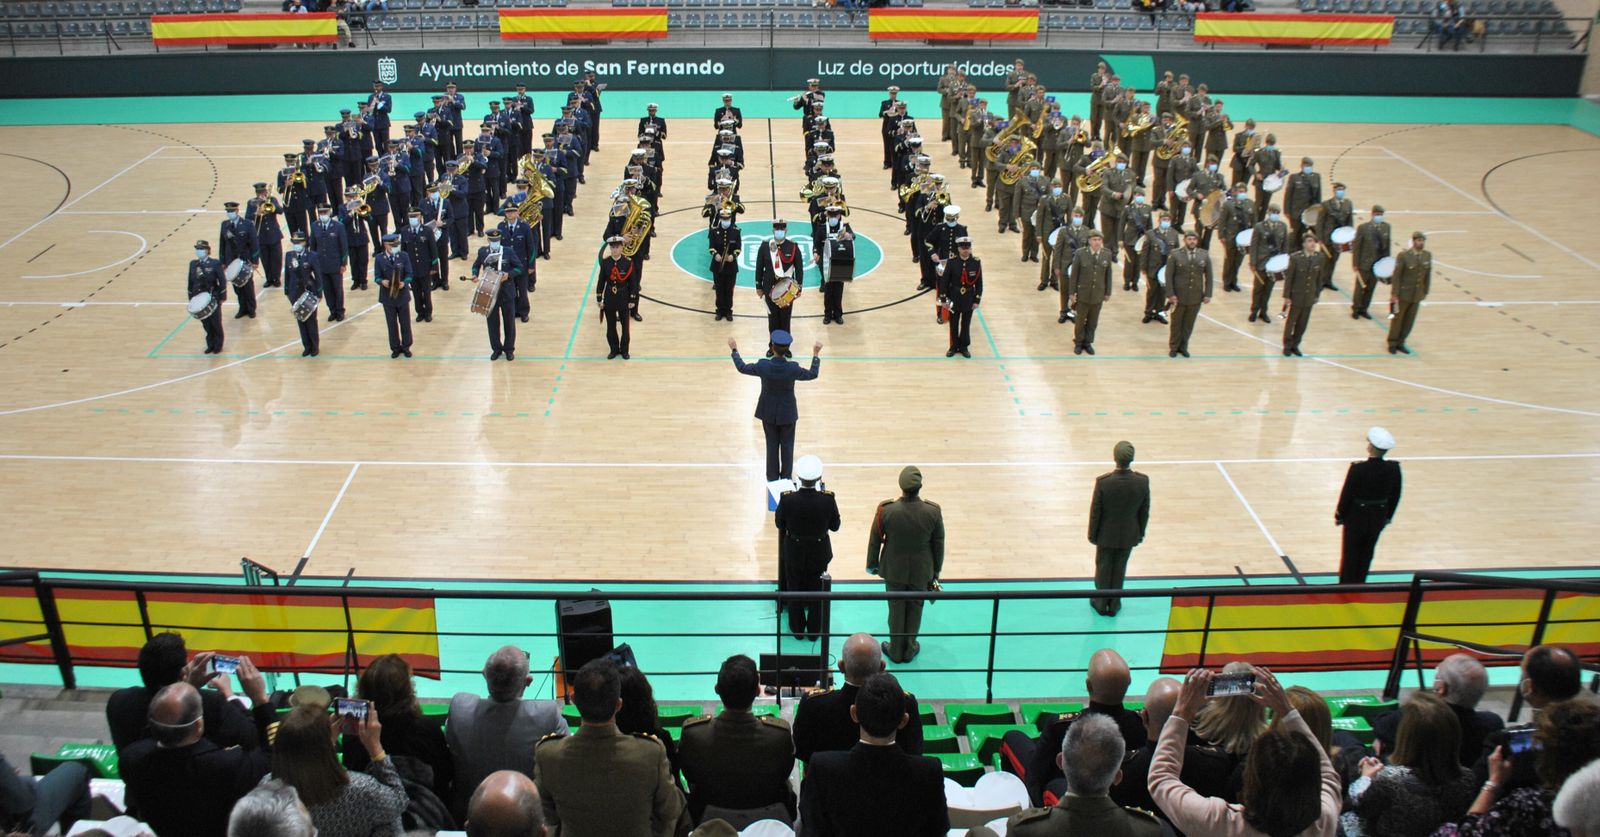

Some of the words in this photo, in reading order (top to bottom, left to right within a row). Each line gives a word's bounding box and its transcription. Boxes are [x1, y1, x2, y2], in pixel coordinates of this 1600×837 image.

[419, 60, 551, 81] Ayuntamiento
[555, 60, 579, 76] de
[584, 60, 622, 75] San
[627, 59, 725, 75] Fernando
[818, 60, 845, 75] Luz
[849, 59, 874, 75] de
